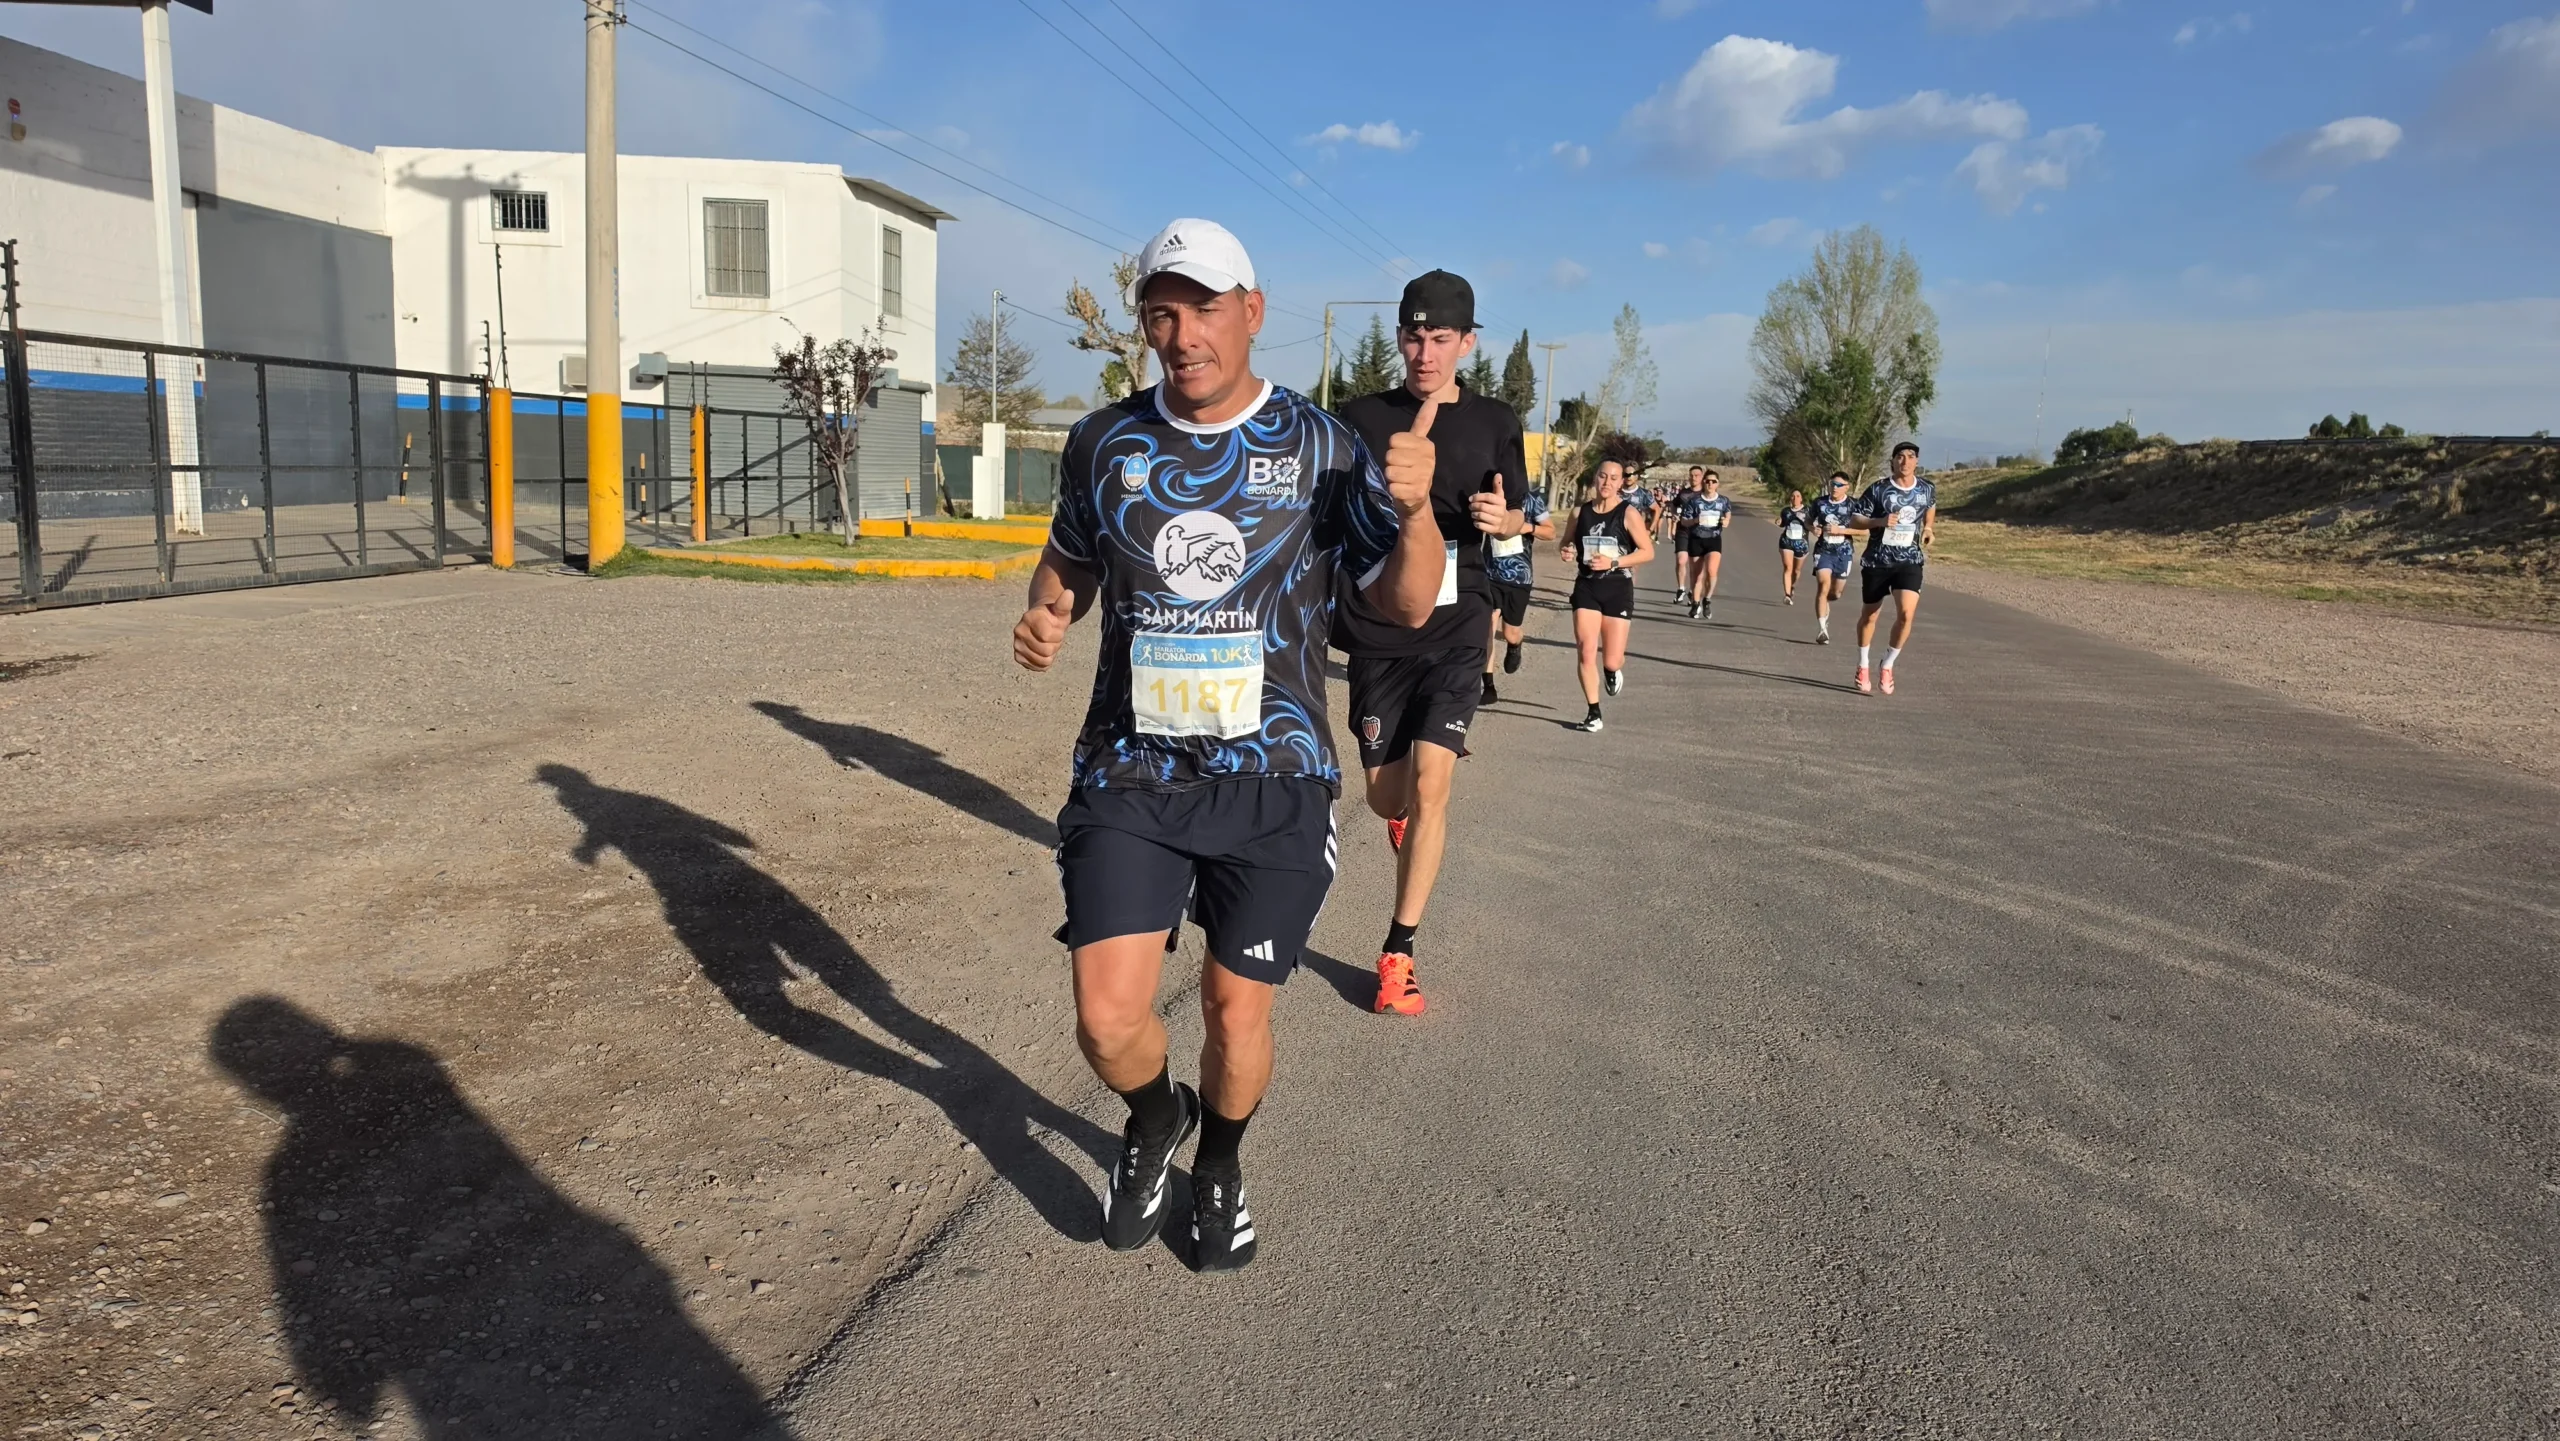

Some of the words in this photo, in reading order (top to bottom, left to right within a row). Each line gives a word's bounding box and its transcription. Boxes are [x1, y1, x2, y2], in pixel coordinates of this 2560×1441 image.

[1160, 245, 1187, 255] adidas
[1247, 486, 1298, 495] BONARDA
[1142, 607, 1177, 625] SAN
[1183, 607, 1257, 628] MARTÍN
[1154, 652, 1208, 662] BONARDA
[1210, 646, 1242, 663] 10K
[1150, 678, 1248, 713] 1187
